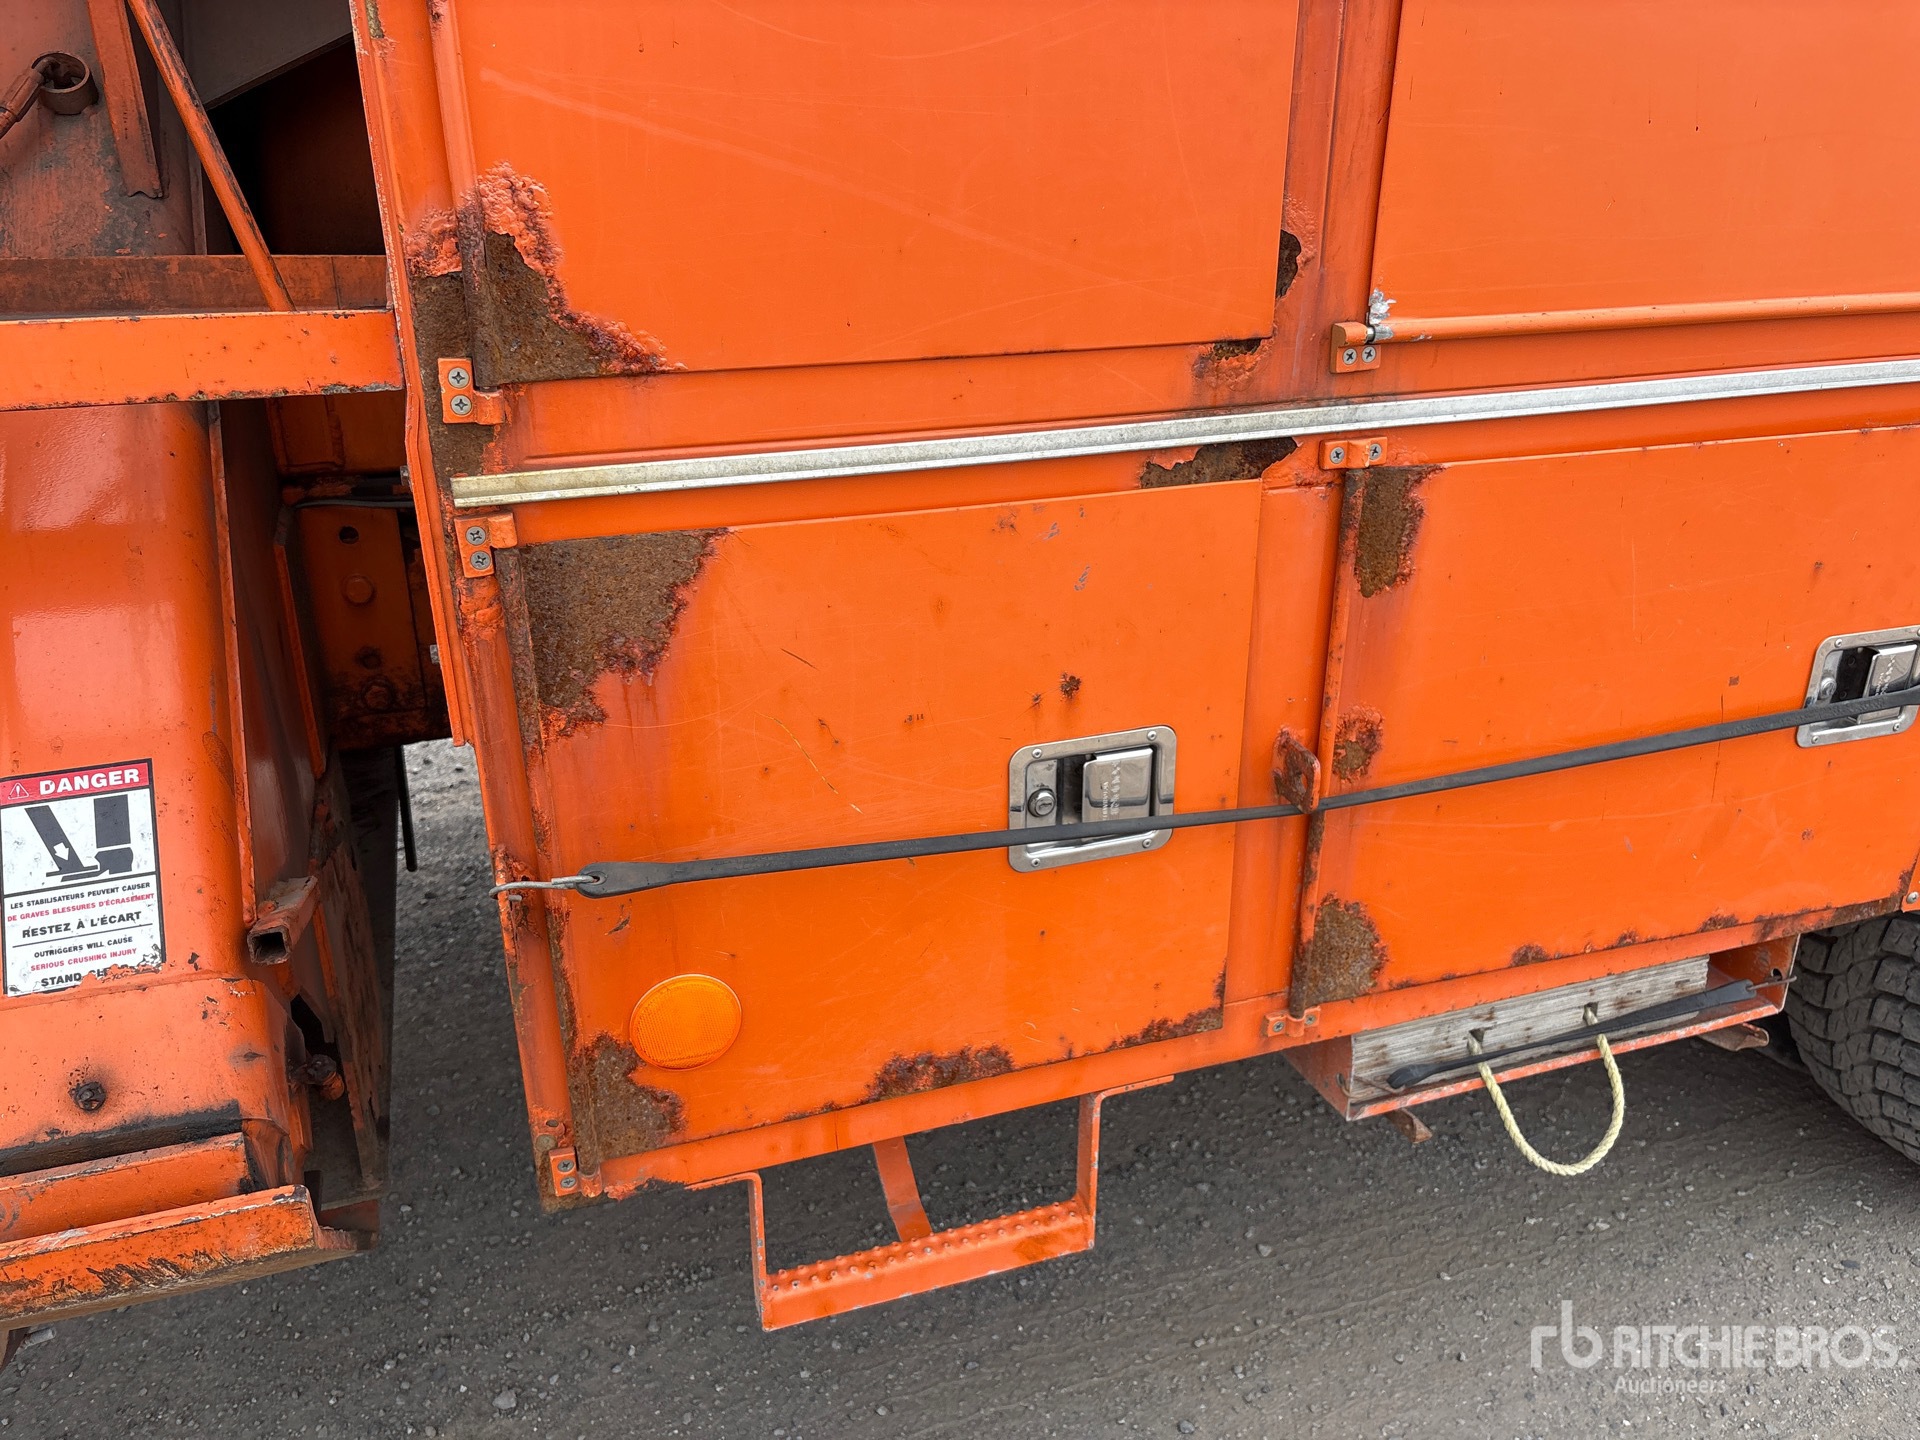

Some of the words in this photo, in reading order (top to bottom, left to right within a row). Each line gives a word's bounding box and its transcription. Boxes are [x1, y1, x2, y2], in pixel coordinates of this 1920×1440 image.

[39, 768, 140, 795] DANGER
[20, 909, 50, 920] GRAVES
[52, 902, 96, 915] BLESSURES
[98, 893, 155, 907] D'ÉCRASEMENT
[26, 892, 85, 907] STABILISATEURS
[87, 887, 120, 897] PEUVENT
[122, 882, 151, 891] CAUSER
[22, 922, 71, 938] RESTEZ
[76, 918, 85, 929] À
[90, 911, 142, 927] L'ÉCART
[34, 944, 84, 958] OUTRIGGERS
[86, 942, 104, 950] WILL
[107, 936, 133, 946] CAUSE
[30, 960, 65, 972] SERIOUS
[68, 953, 107, 965] CRUSHING
[110, 948, 137, 958] INJURY
[40, 972, 82, 987] STAND
